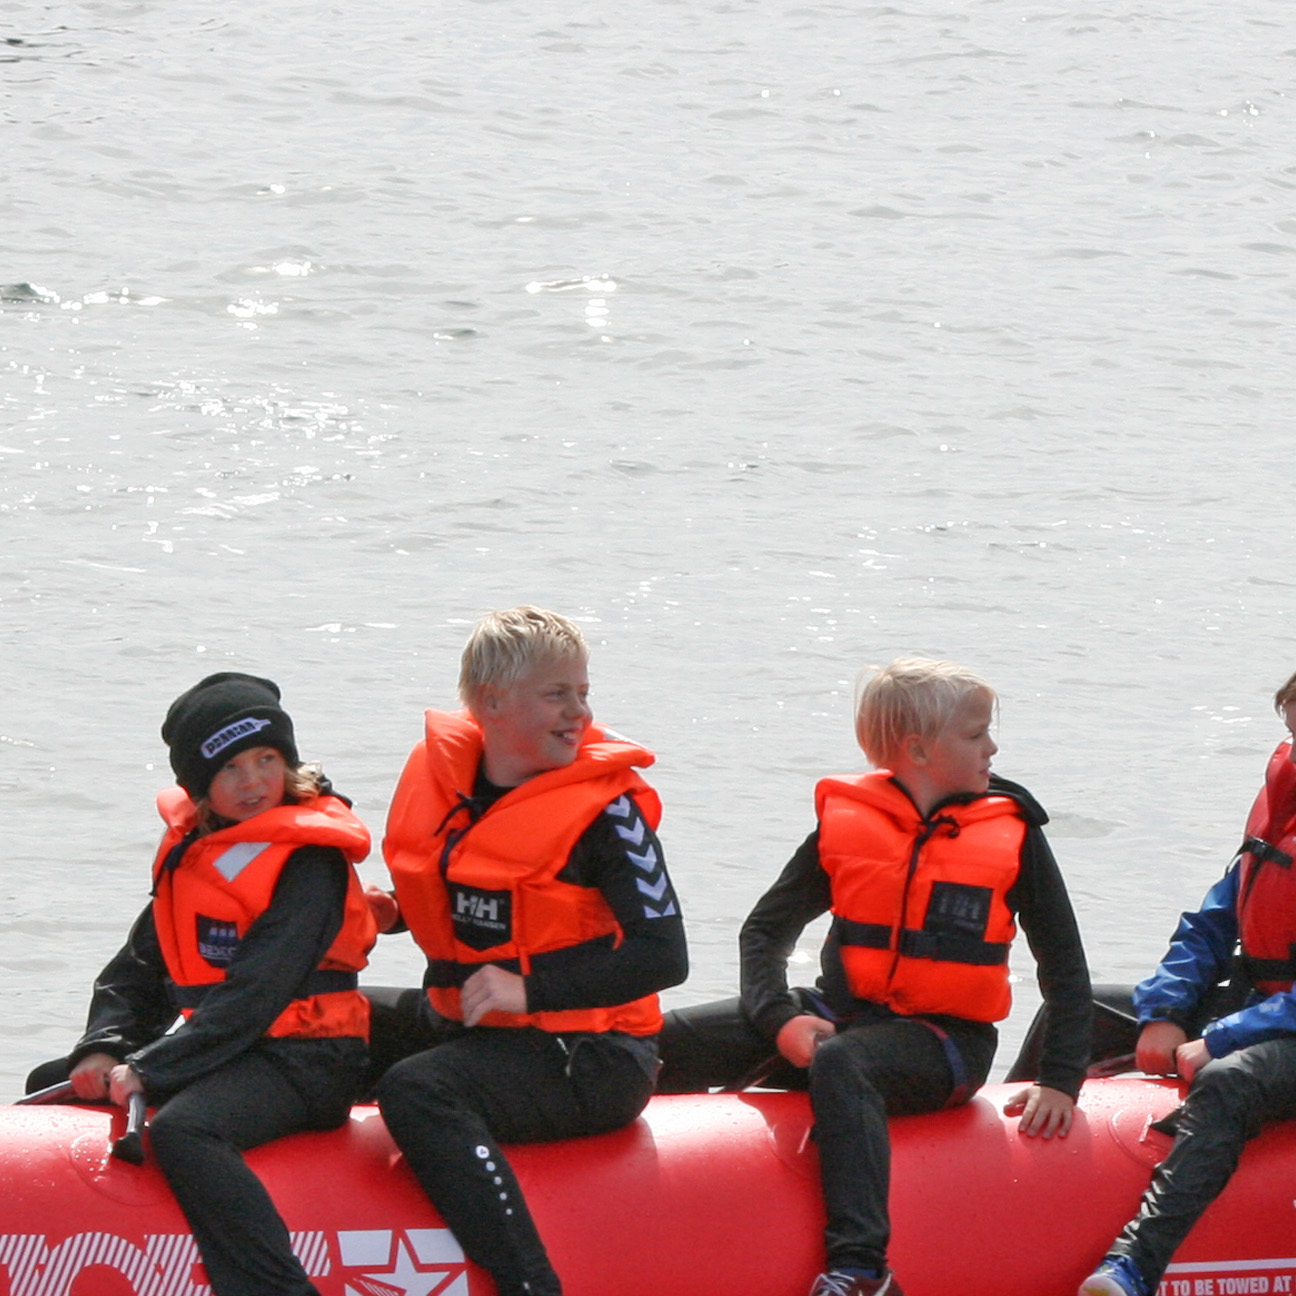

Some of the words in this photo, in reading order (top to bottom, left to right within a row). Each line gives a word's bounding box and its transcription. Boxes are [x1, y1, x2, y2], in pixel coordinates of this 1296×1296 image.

[1171, 1280, 1191, 1296] TO
[1195, 1279, 1214, 1296] BE
[1216, 1276, 1269, 1295] TOWED
[1273, 1275, 1292, 1292] AT
